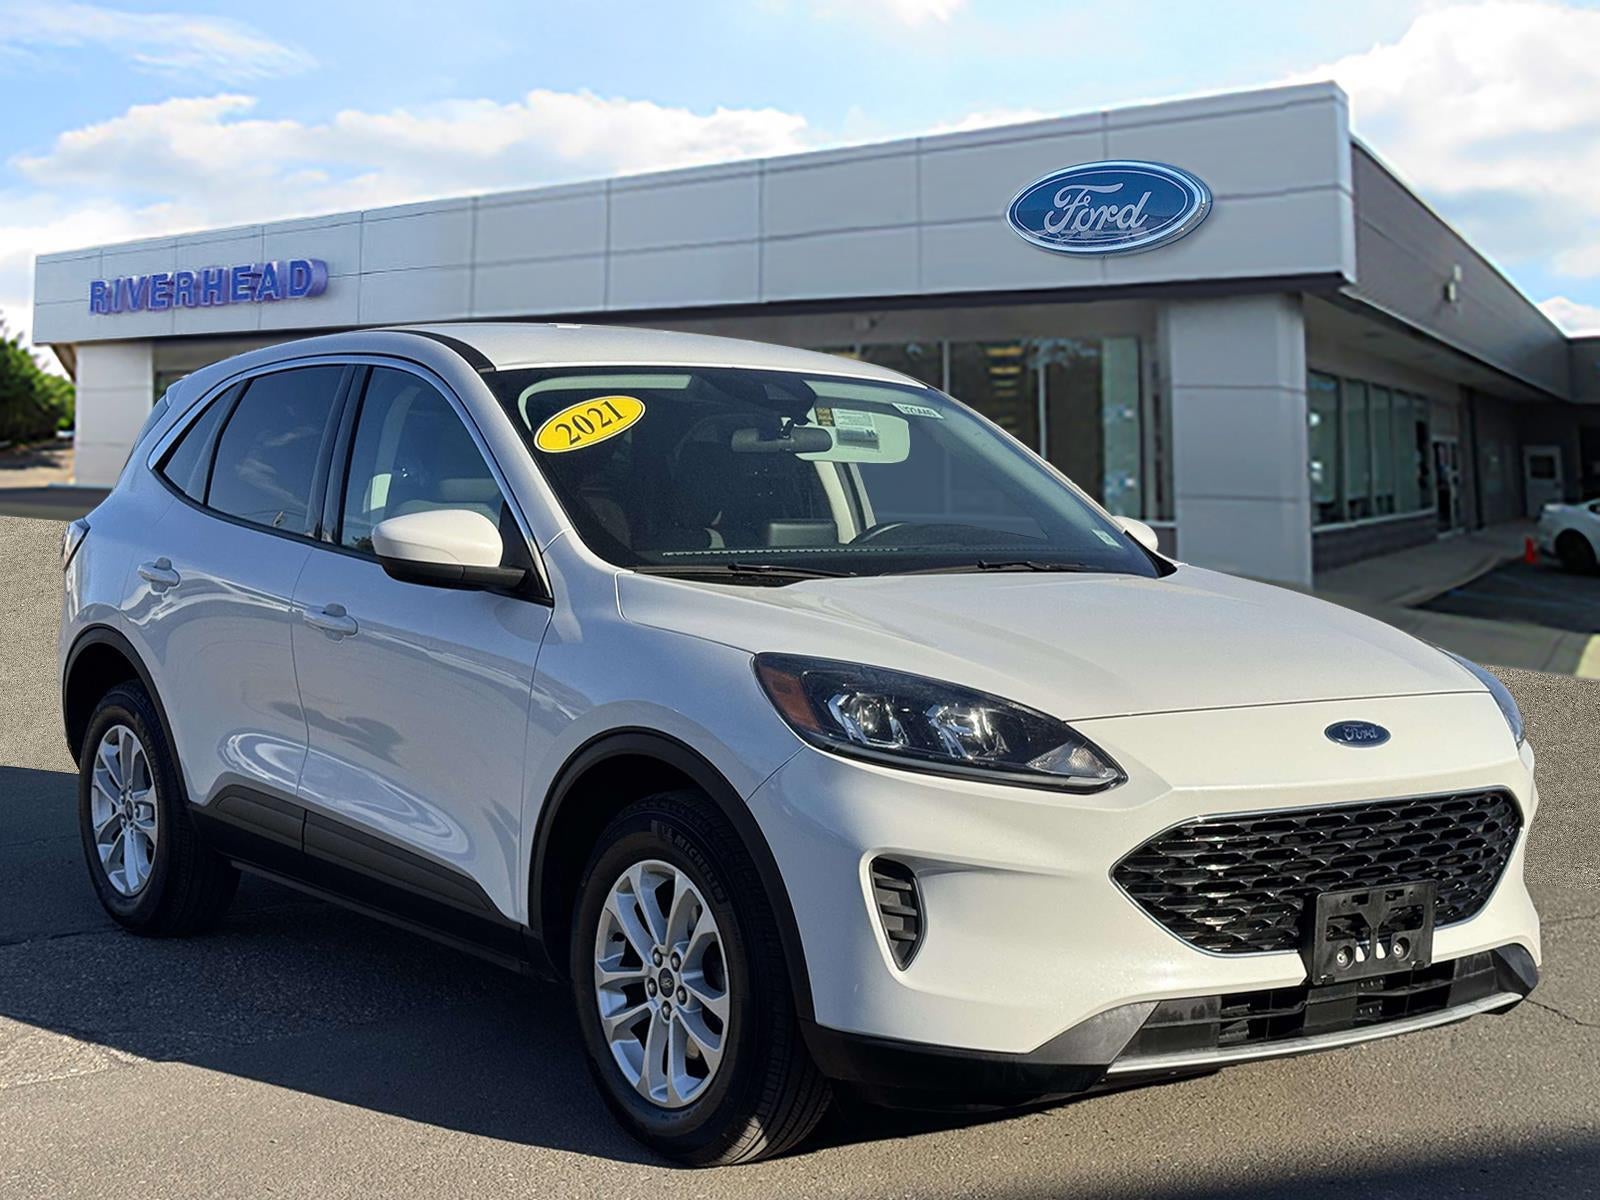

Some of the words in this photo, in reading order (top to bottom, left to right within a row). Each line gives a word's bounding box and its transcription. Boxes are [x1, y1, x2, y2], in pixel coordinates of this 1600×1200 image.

[1044, 183, 1152, 234] Ford
[89, 258, 326, 315] RIVERHEAD
[555, 401, 627, 445] 2021
